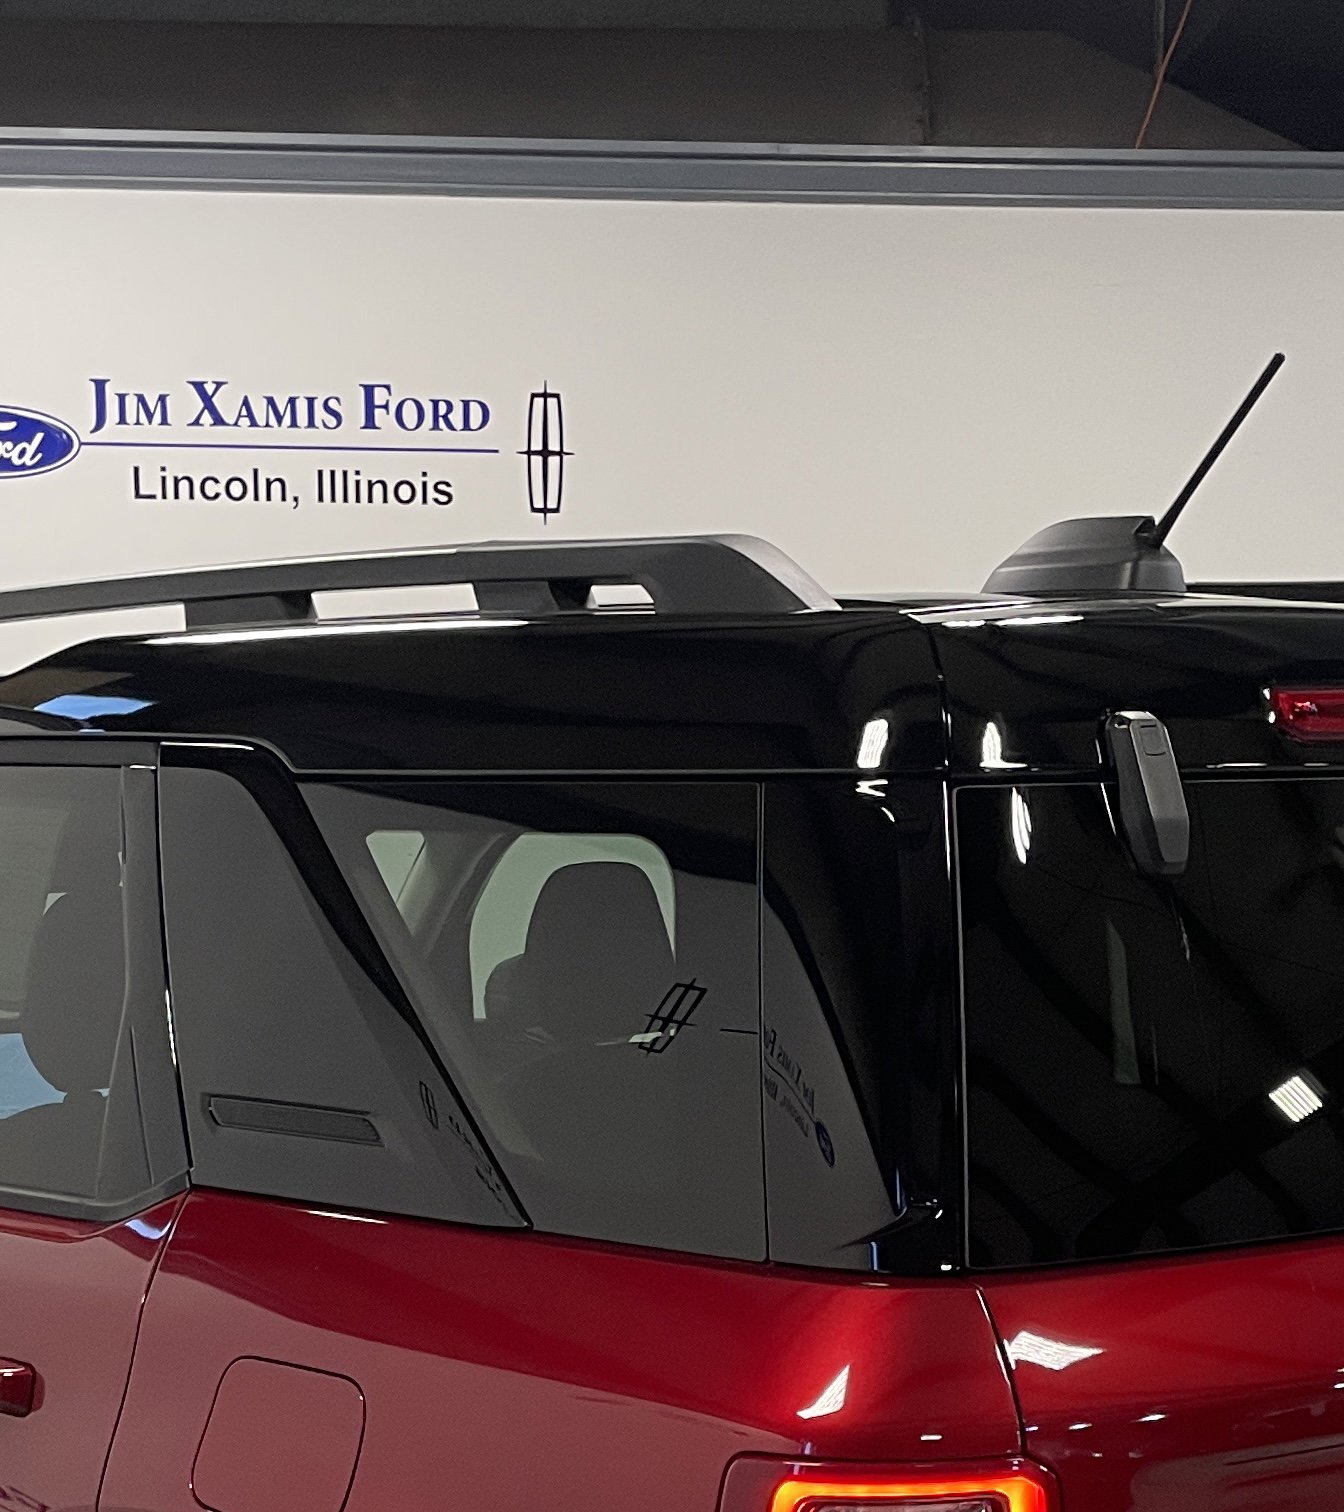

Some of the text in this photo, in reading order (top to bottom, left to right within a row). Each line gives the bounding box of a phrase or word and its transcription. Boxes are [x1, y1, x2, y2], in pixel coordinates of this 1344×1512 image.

[88, 378, 491, 434] JIM XAMIS FORD
[133, 465, 454, 510] Lincoln, Illinois
